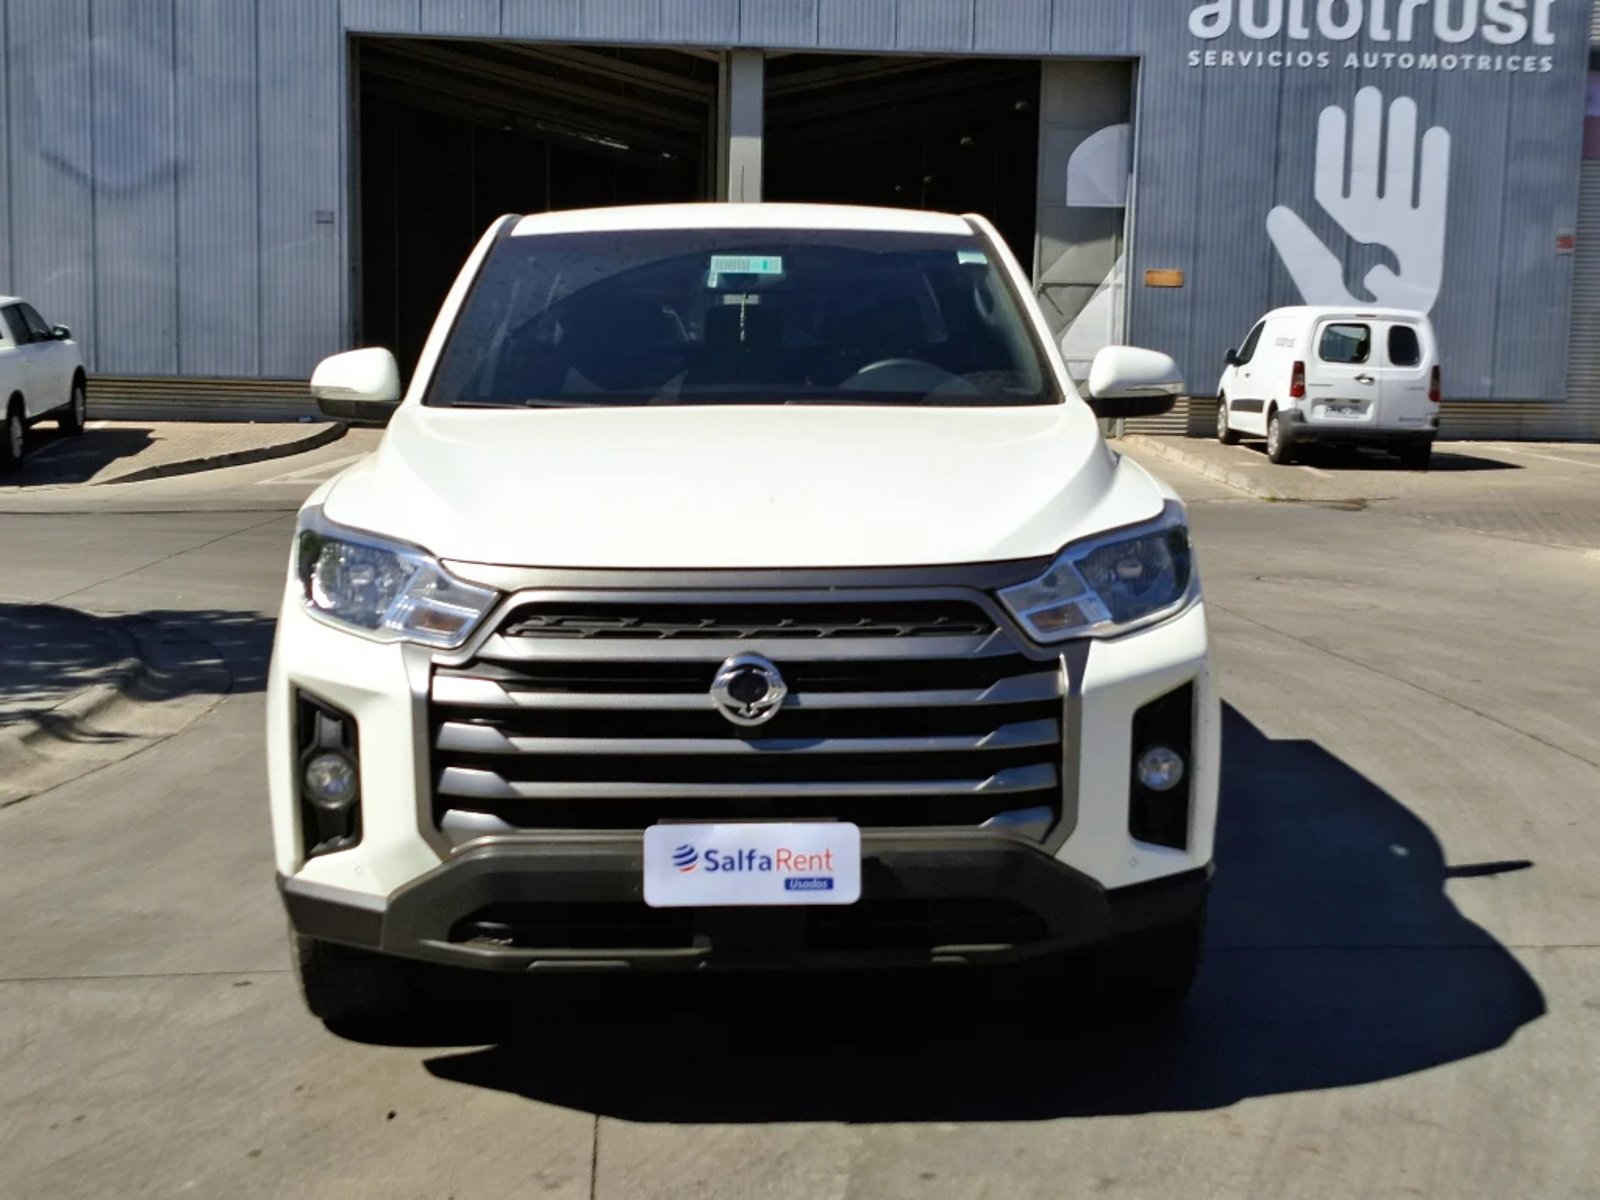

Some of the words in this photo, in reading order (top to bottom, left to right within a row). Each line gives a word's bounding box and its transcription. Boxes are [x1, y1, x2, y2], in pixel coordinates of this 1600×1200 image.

[1188, 51, 1330, 68] SERVICIOS
[1343, 52, 1553, 73] AUTOMOTRICES
[704, 848, 834, 872] SalfaRent
[789, 878, 829, 891] Usados
